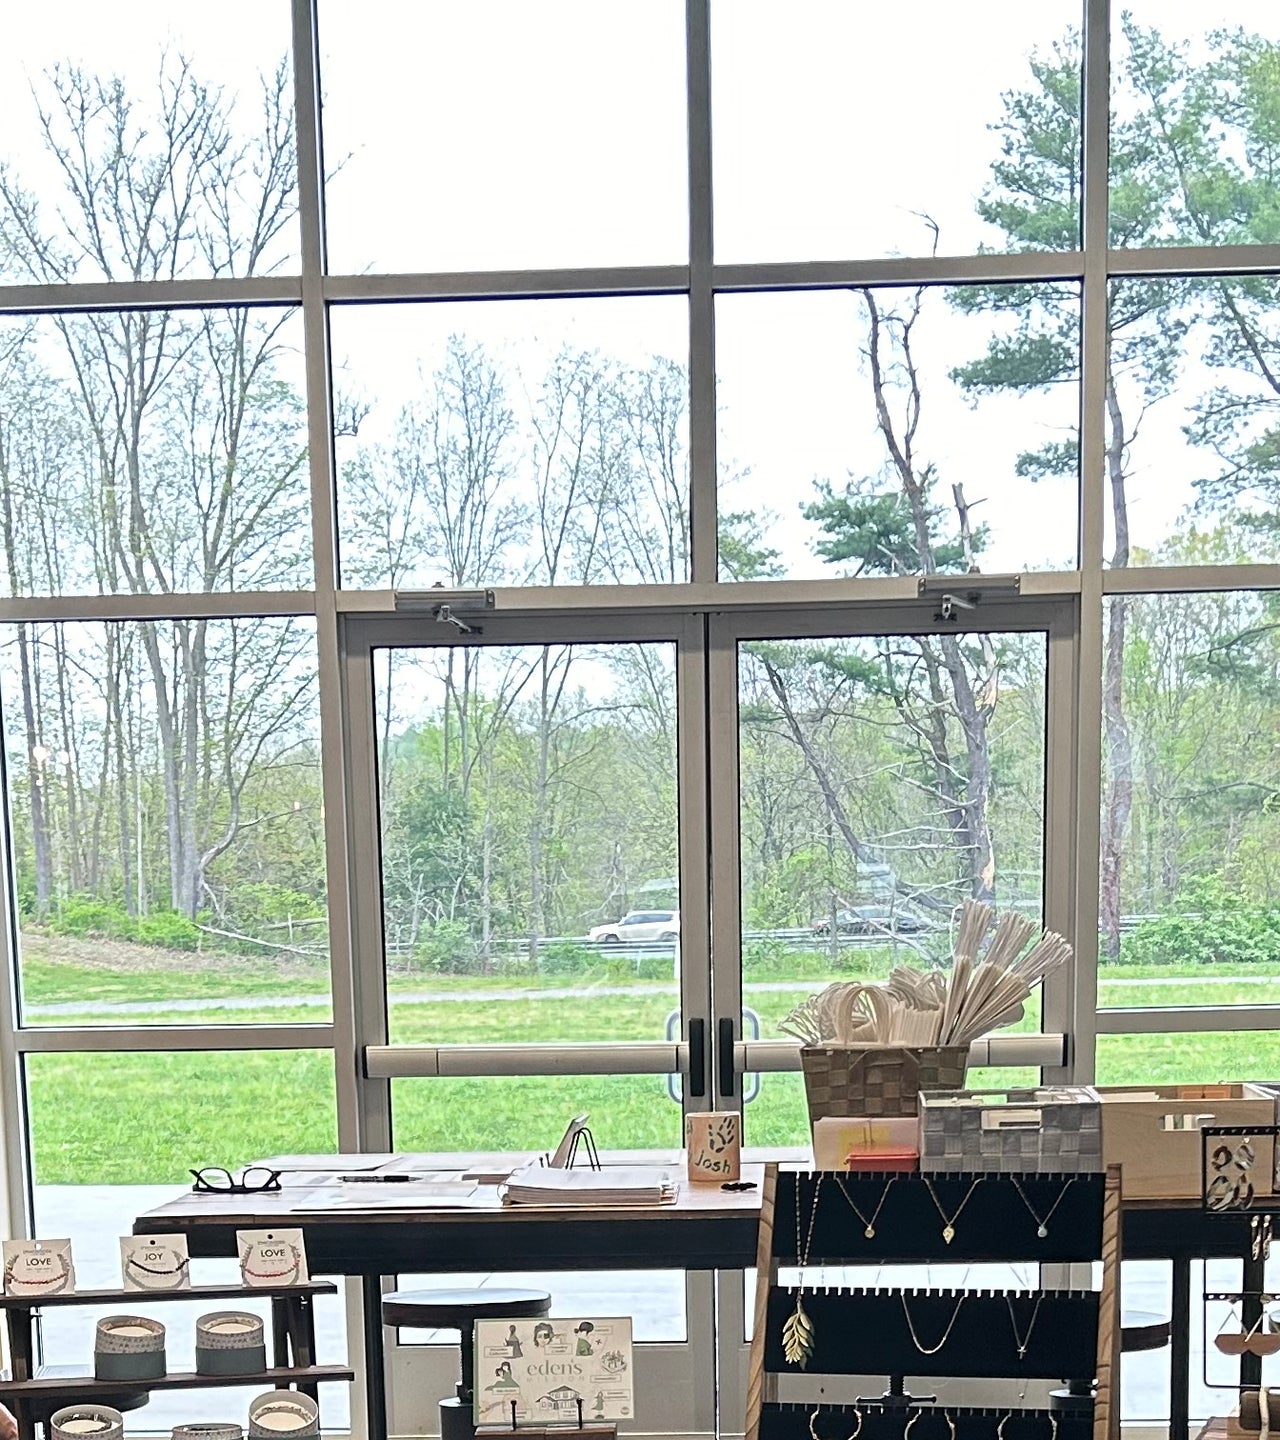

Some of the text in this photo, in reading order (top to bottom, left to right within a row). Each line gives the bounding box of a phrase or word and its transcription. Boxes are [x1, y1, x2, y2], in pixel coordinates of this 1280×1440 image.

[144, 1252, 163, 1262] JOY
[260, 1249, 286, 1258] LOVE
[26, 1258, 52, 1266] LOVE
[526, 1358, 583, 1377] eden's
